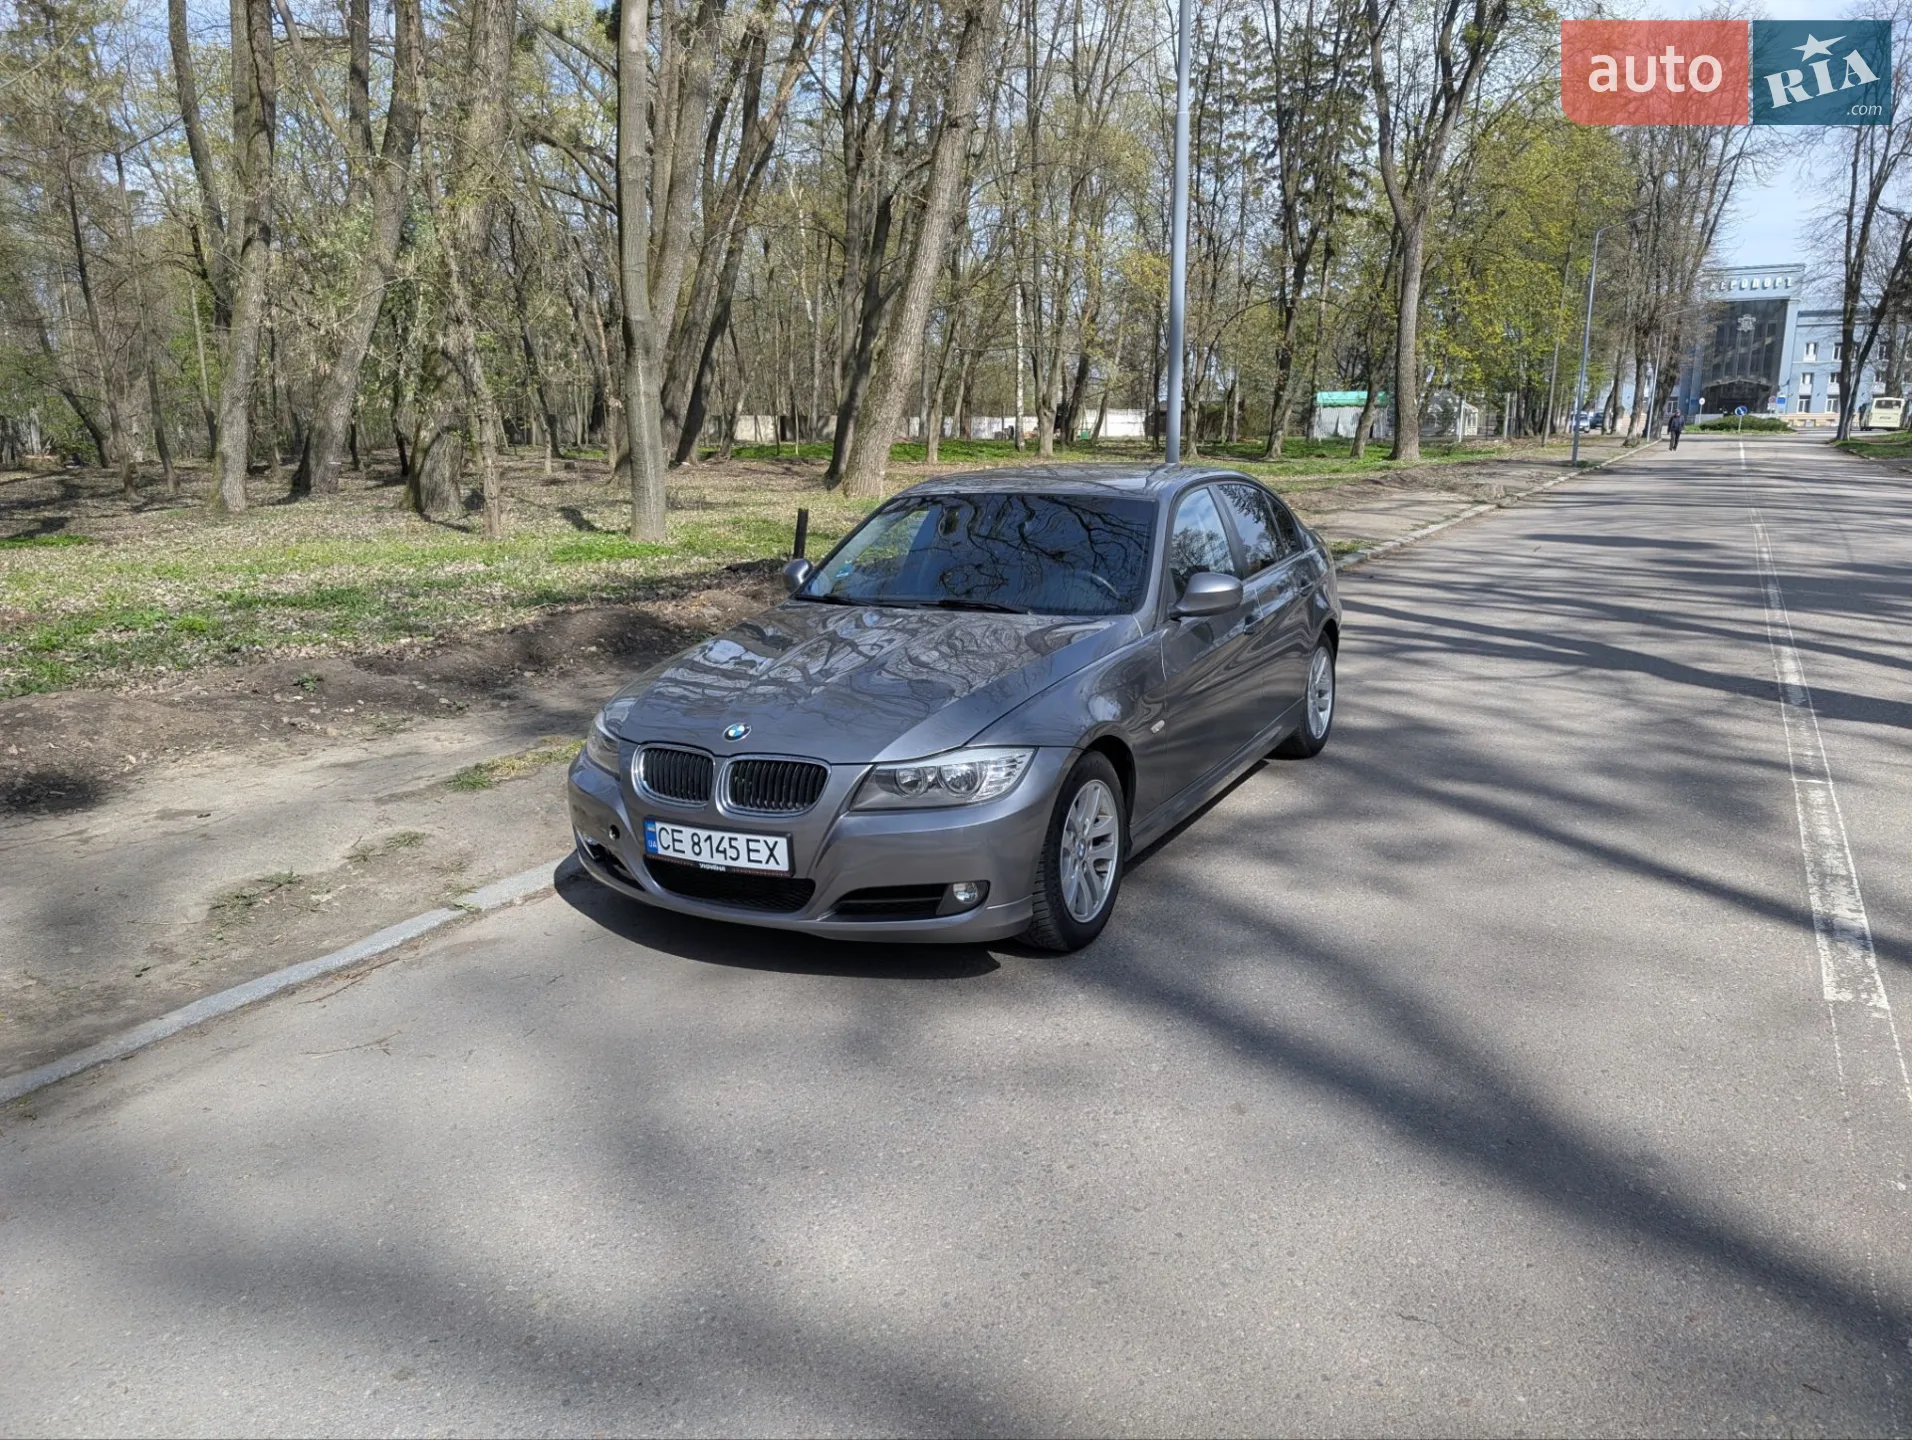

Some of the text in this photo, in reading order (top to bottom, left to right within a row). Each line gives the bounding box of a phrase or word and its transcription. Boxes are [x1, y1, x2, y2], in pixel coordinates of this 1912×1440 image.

[658, 827, 781, 865] CE 8145 EX
